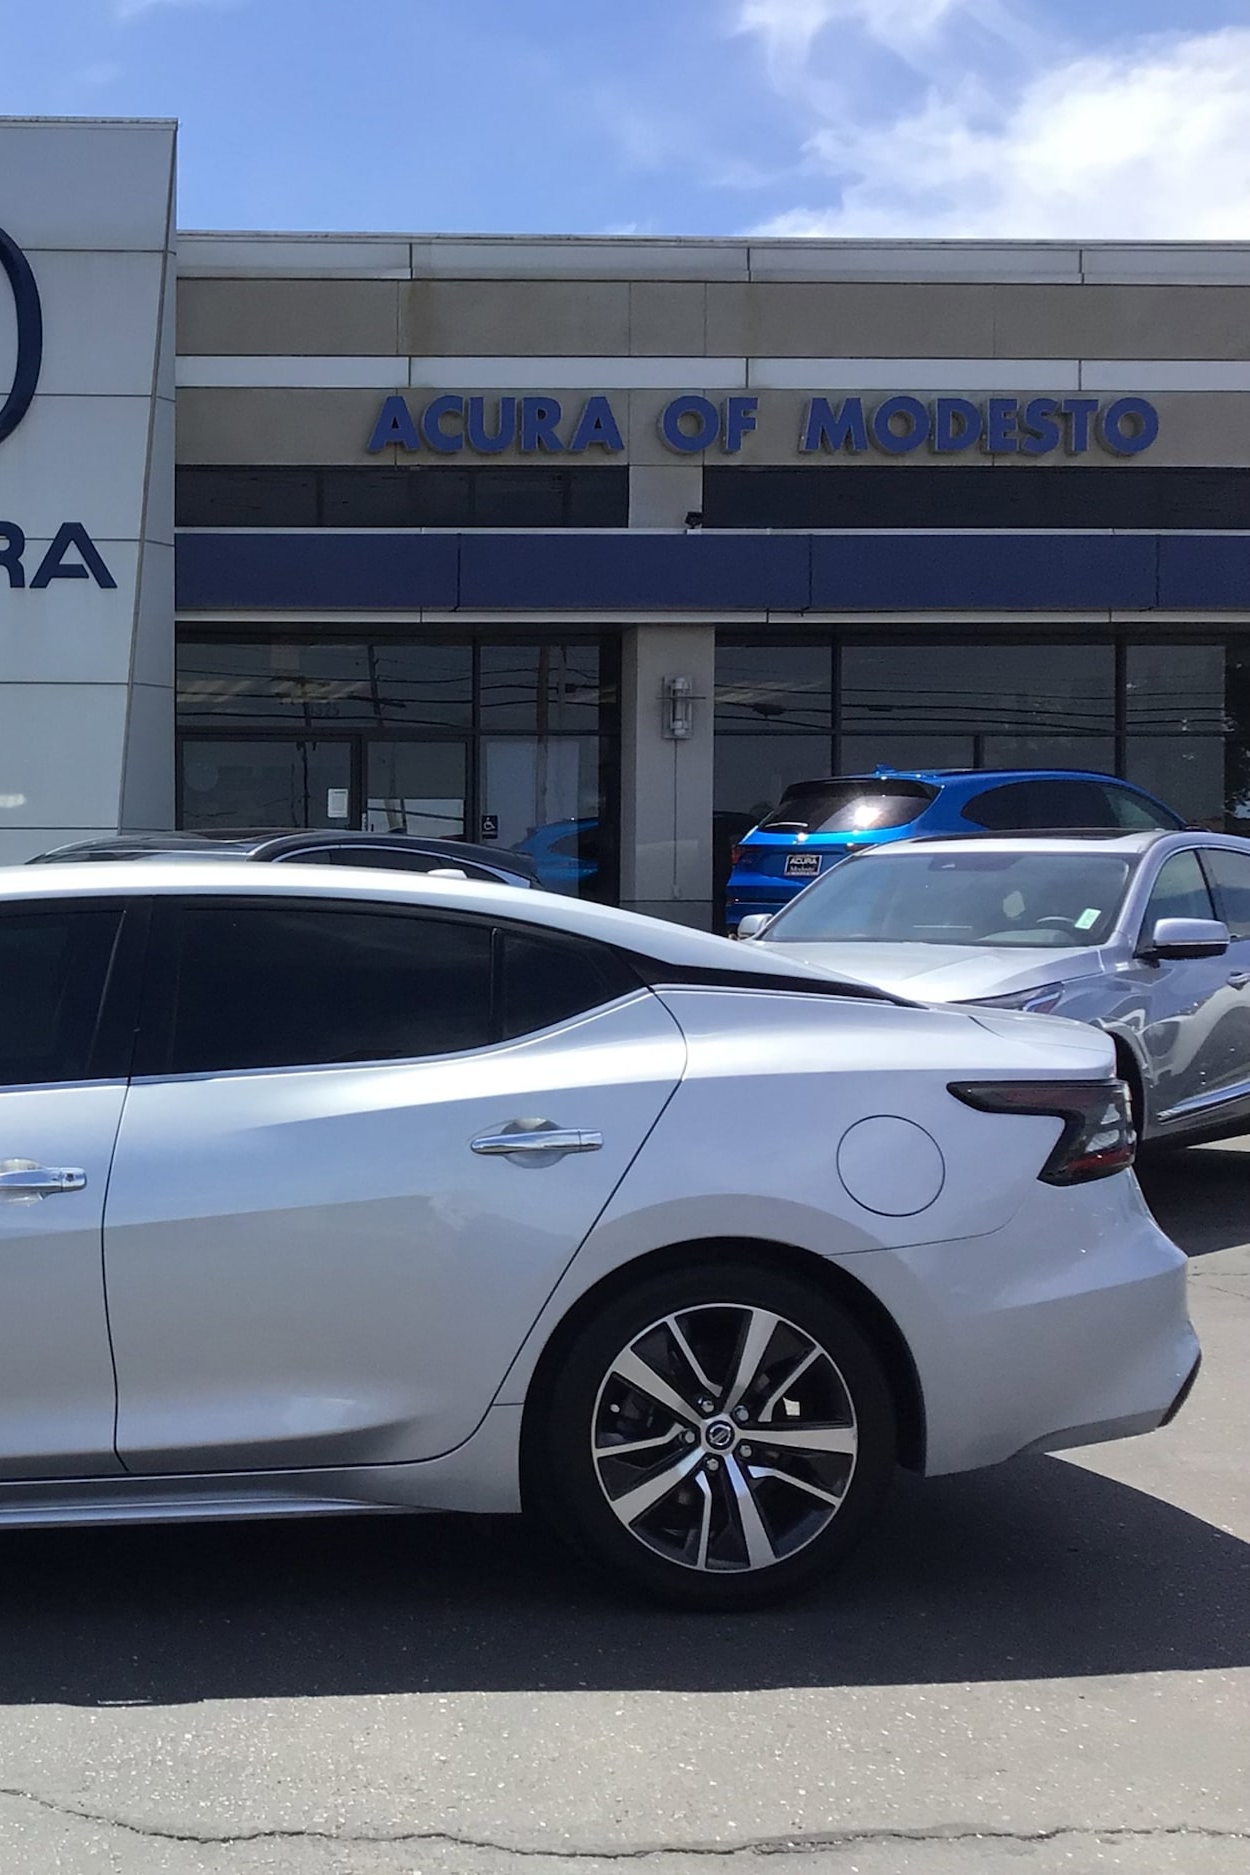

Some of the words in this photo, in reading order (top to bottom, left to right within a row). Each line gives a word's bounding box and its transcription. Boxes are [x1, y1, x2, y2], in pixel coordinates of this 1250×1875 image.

[366, 395, 624, 453] ACURA
[661, 395, 759, 454] OF
[803, 396, 1160, 454] MODESTO
